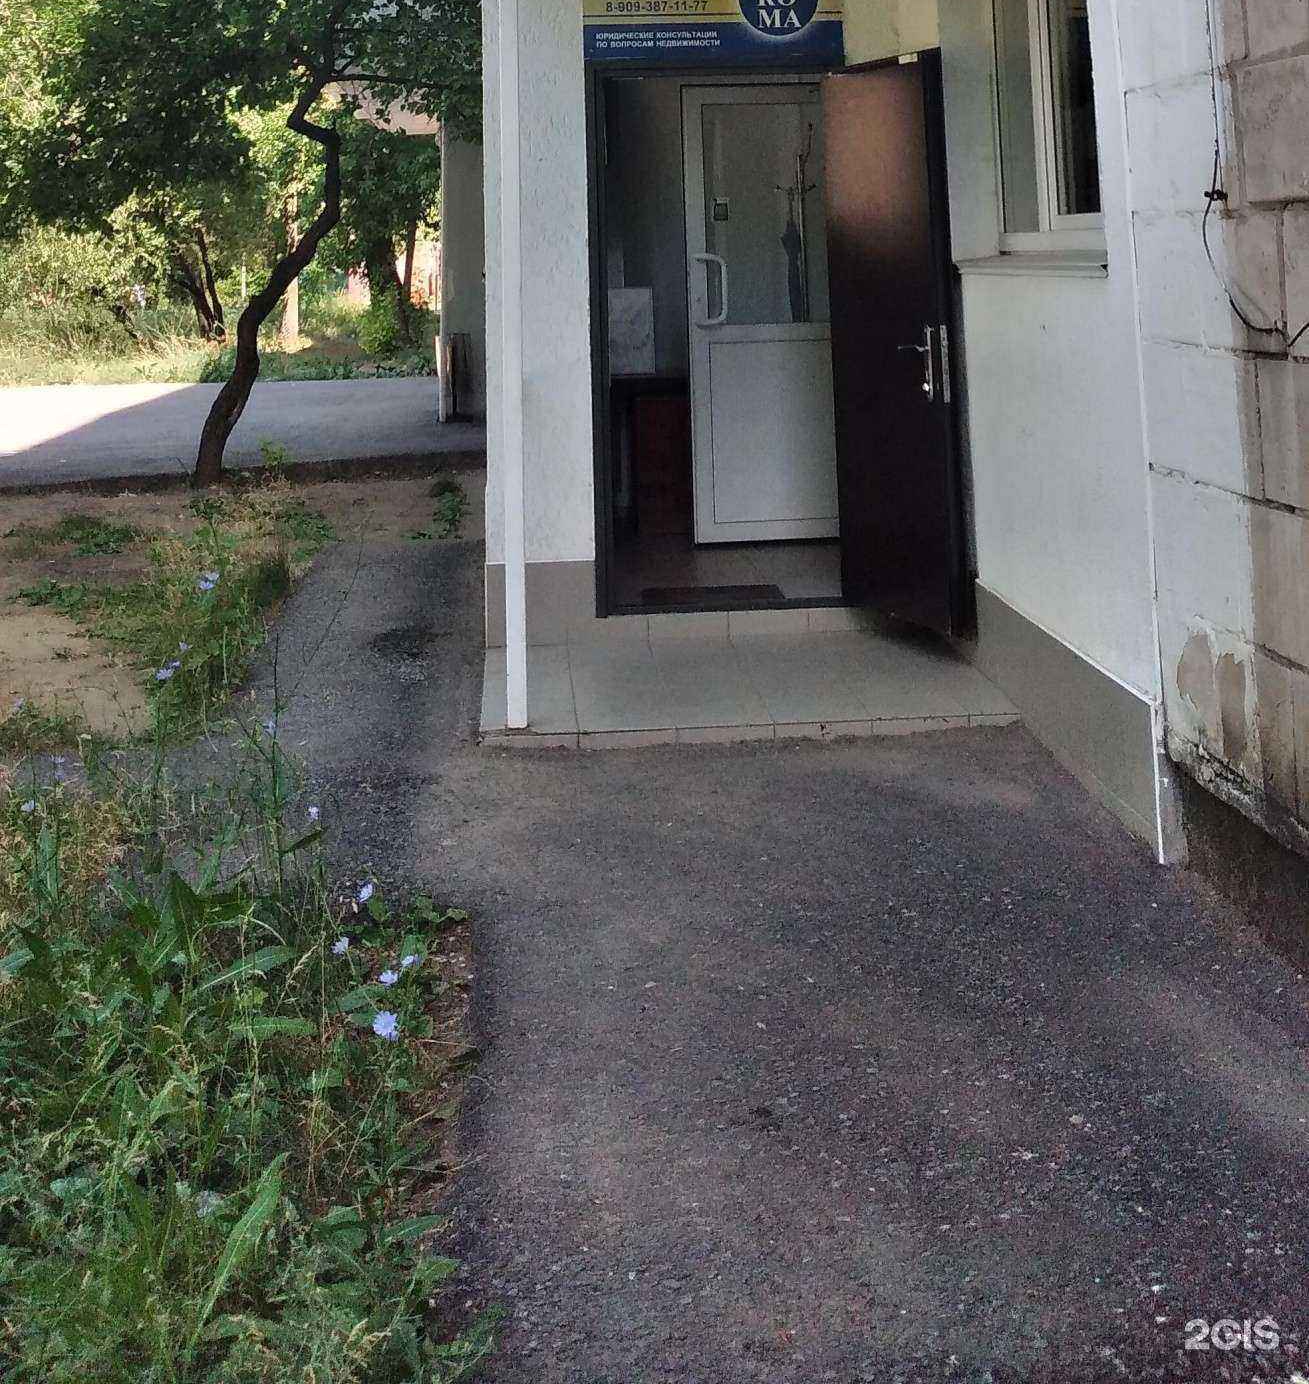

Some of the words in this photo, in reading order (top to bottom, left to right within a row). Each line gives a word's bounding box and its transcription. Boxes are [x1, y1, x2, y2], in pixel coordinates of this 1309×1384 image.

[606, 0, 709, 12] 8-909-387-11-77
[758, 8, 801, 28] МА
[595, 32, 654, 40] ЮРИДИЧЕСКИЕ
[656, 31, 718, 39] КОНСУЛЬТАЦИИ
[610, 40, 654, 48] ВОПРОСАМ
[656, 39, 720, 47] НЕДВИЖИМОСТИ
